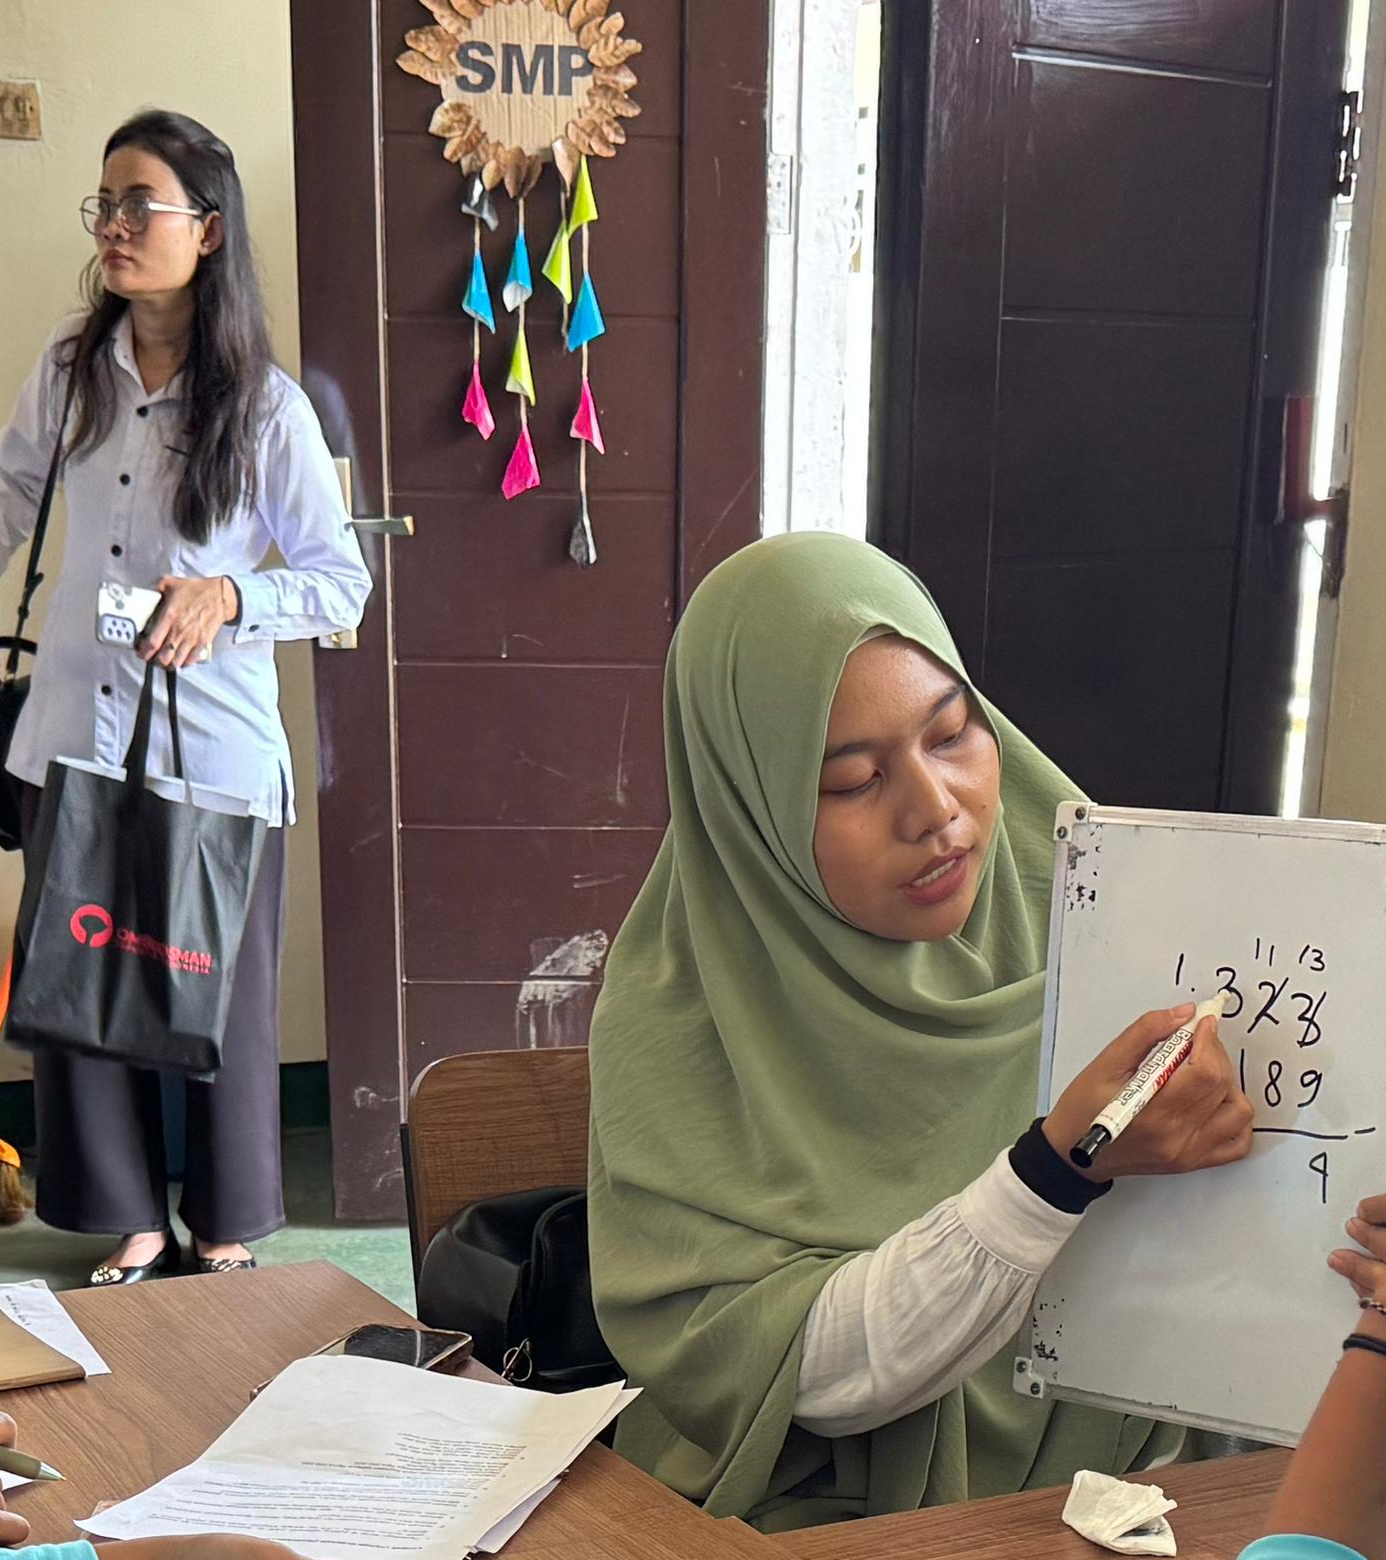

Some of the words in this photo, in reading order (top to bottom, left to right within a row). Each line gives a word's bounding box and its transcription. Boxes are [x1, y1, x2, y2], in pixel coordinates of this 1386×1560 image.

[456, 41, 593, 96] SMP
[1175, 953, 1196, 993] 1.
[1299, 944, 1326, 972] 13
[1118, 1028, 1193, 1107] Boardmarker
[1240, 1048, 1324, 1109] 189
